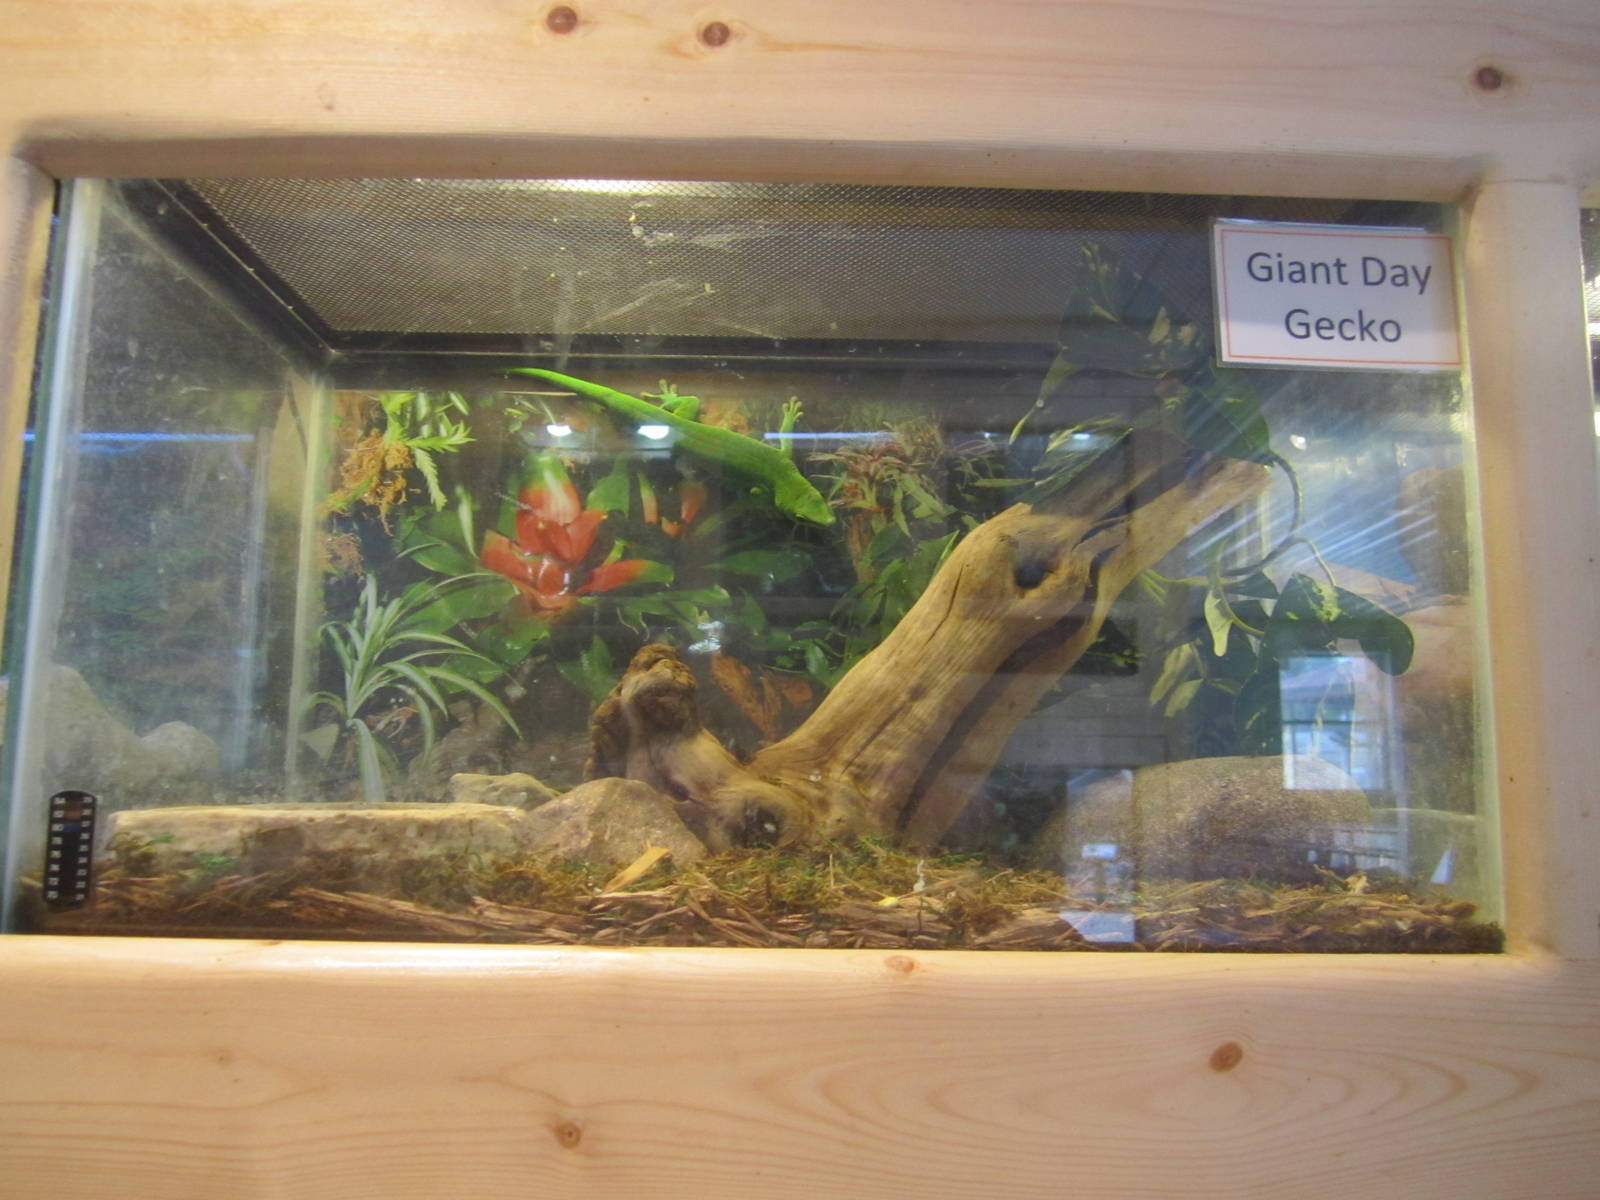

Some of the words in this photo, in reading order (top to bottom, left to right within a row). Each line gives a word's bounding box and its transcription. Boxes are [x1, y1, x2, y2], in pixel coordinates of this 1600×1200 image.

[1247, 252, 1349, 286] Giant
[1362, 256, 1432, 295] Day
[1285, 308, 1402, 343] Gecko
